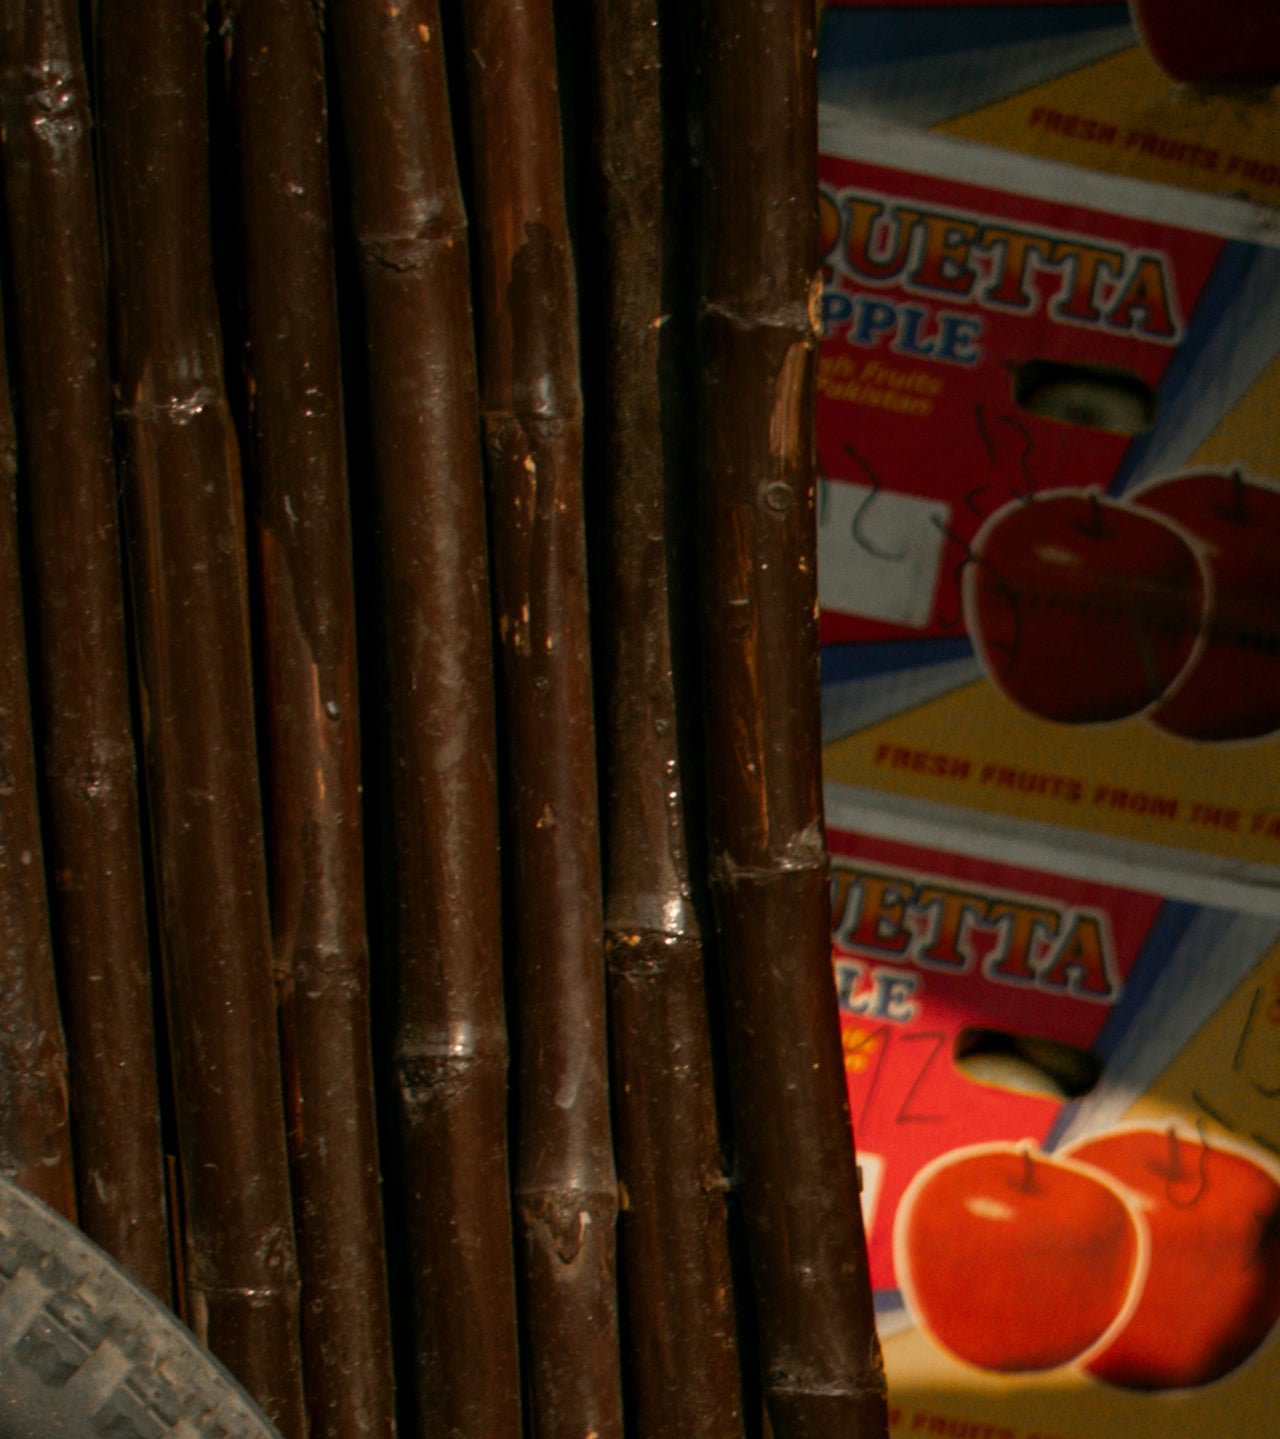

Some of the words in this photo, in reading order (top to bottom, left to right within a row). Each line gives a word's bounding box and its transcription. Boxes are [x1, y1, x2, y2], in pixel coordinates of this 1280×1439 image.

[1026, 105, 1117, 148] FRESH
[1122, 128, 1220, 172] FRUITS
[821, 293, 982, 360] PPLE
[873, 741, 972, 782] FRESH
[980, 760, 1083, 805] FRUITS
[1093, 782, 1178, 822] FROM
[1190, 801, 1241, 833] THE
